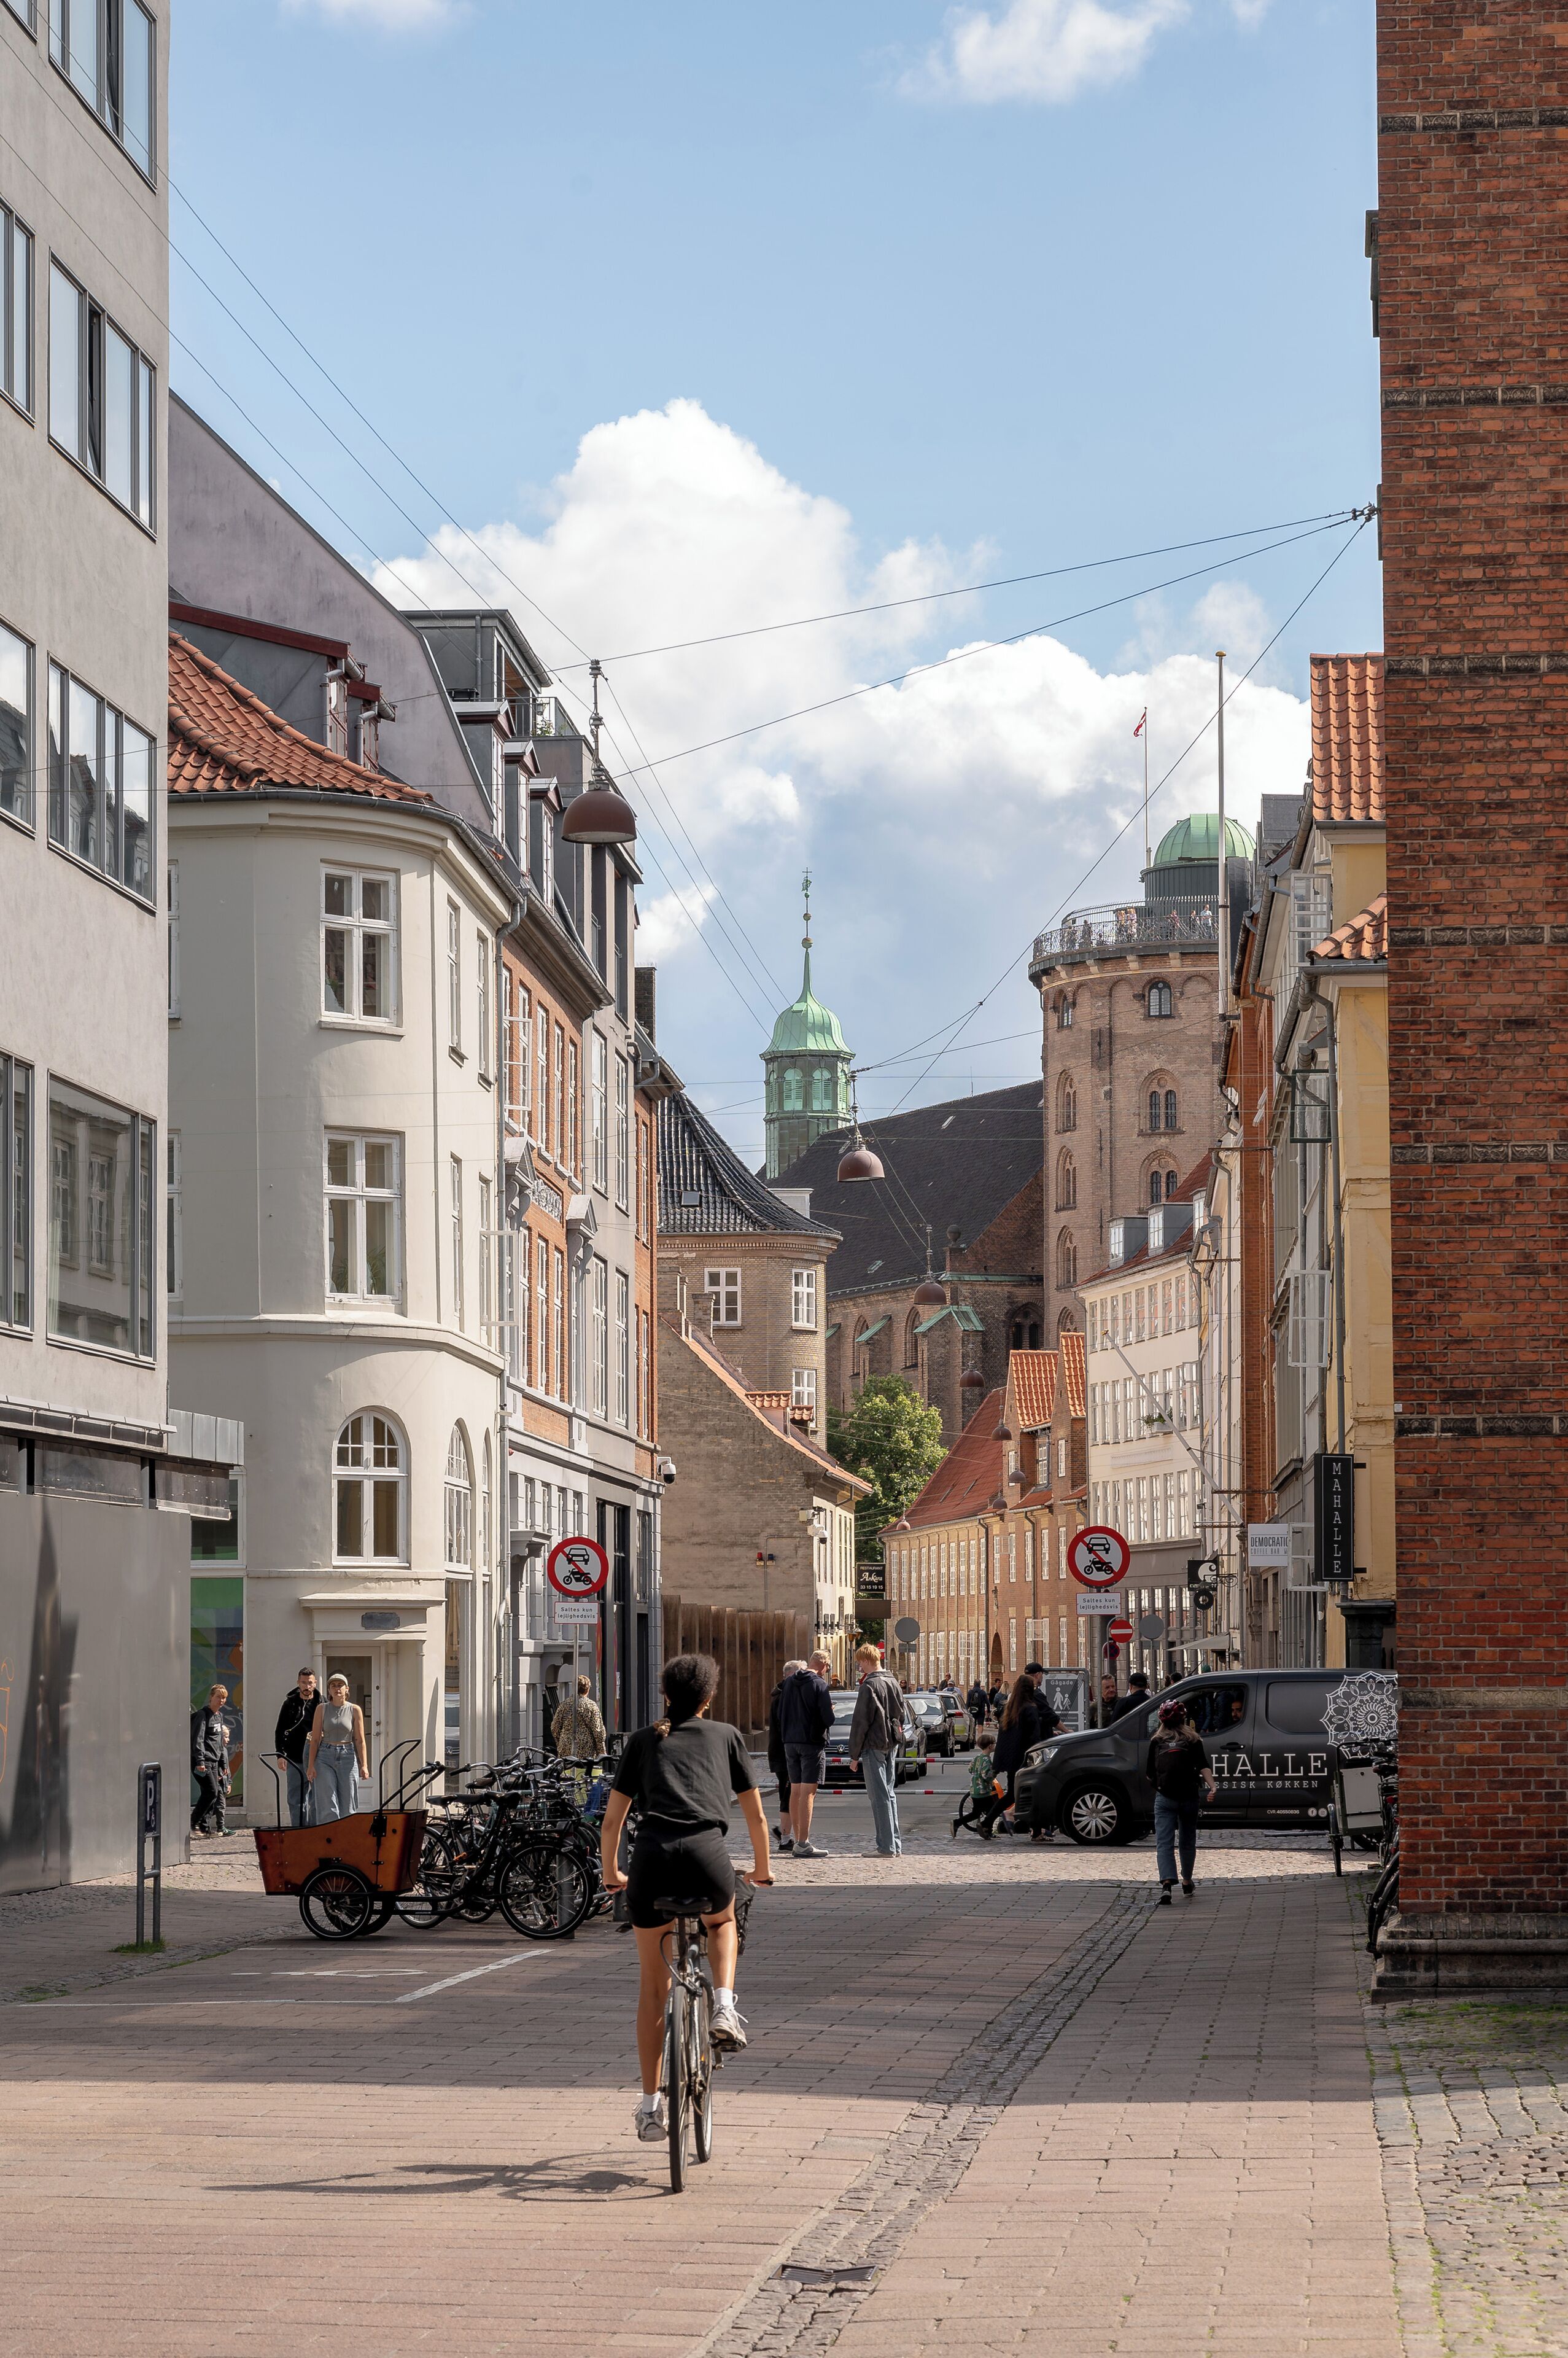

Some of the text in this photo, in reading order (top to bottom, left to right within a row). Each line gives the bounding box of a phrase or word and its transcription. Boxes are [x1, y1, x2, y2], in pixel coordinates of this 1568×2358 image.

[1333, 1462, 1342, 1573] MAHALLE
[860, 1572, 883, 1582] Ankara
[1199, 1753, 1327, 1776] HALLE
[147, 1780, 154, 1821] P
